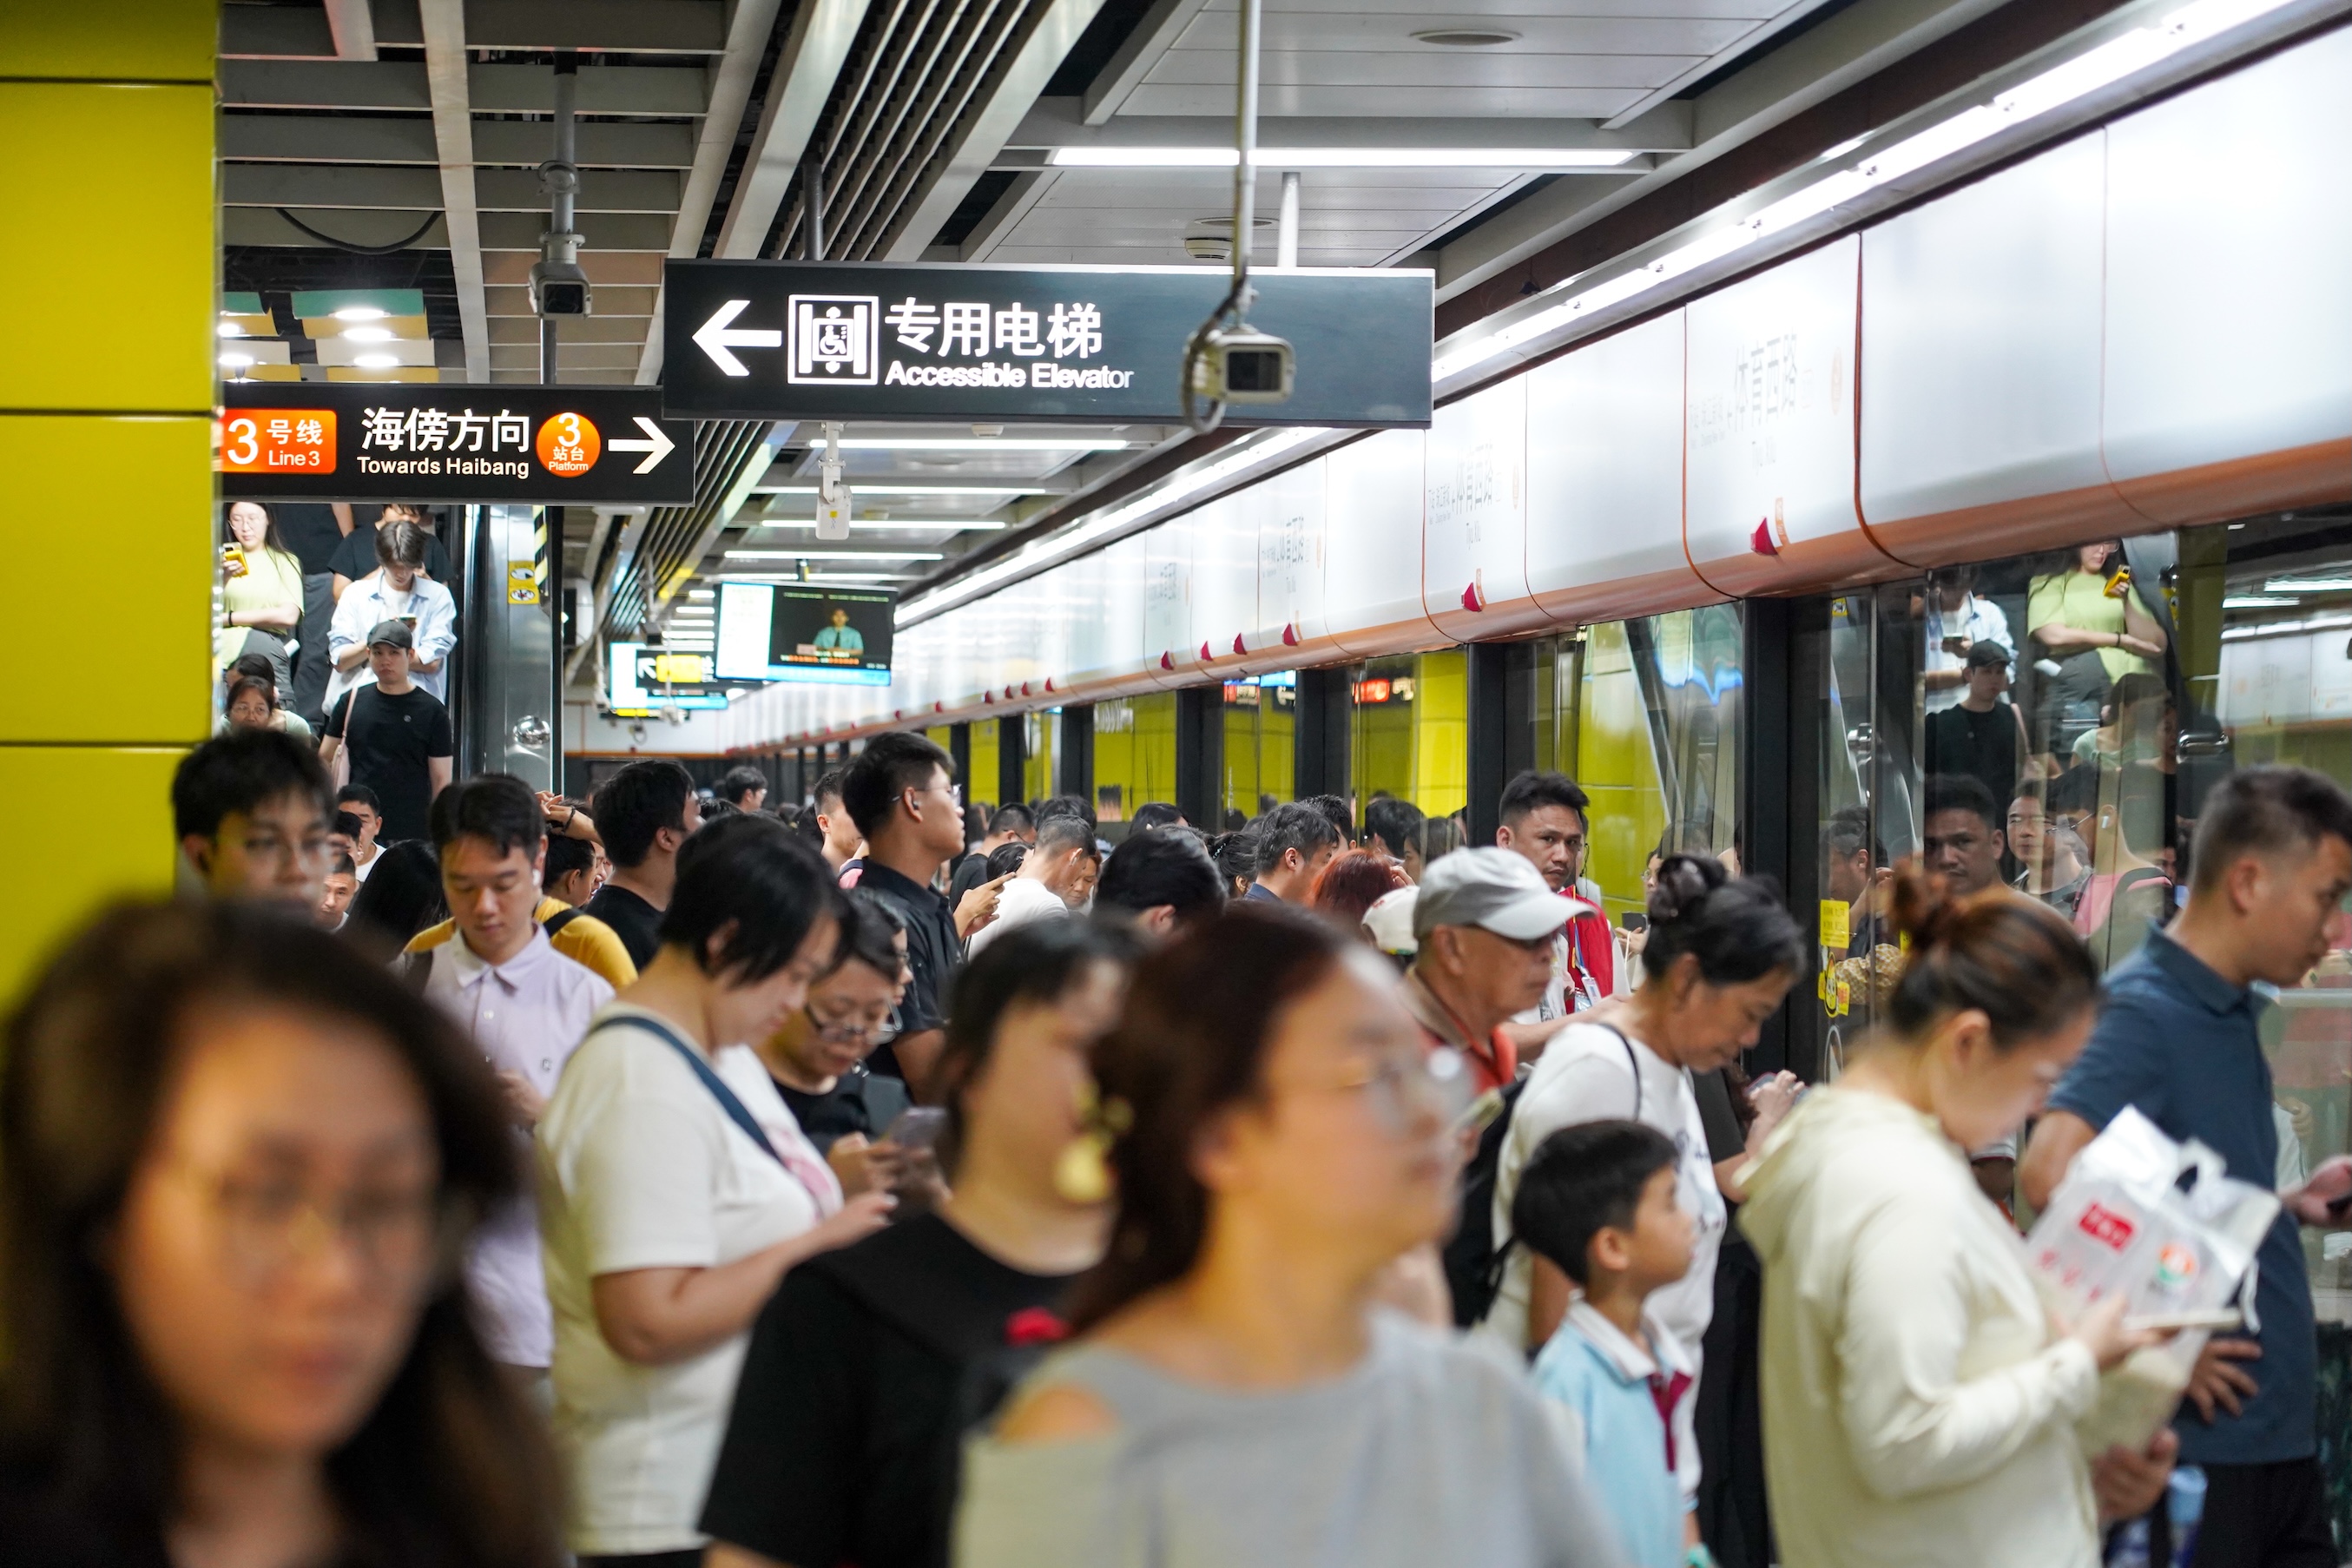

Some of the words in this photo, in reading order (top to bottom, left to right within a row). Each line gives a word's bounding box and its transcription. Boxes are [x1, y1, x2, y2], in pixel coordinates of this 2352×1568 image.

[884, 296, 1103, 359] 专用电梯
[884, 359, 1027, 388] Accessible
[1031, 362, 1135, 389] Elevator
[227, 418, 259, 465] 3
[266, 418, 324, 445] 号线
[361, 406, 530, 453] 海傍方向
[557, 412, 581, 447] 3
[268, 450, 305, 466] Line
[308, 450, 320, 466] 3
[356, 456, 441, 475] Towards
[446, 457, 529, 479] Haibang
[548, 460, 590, 471] Platform
[552, 445, 584, 461] 站台
